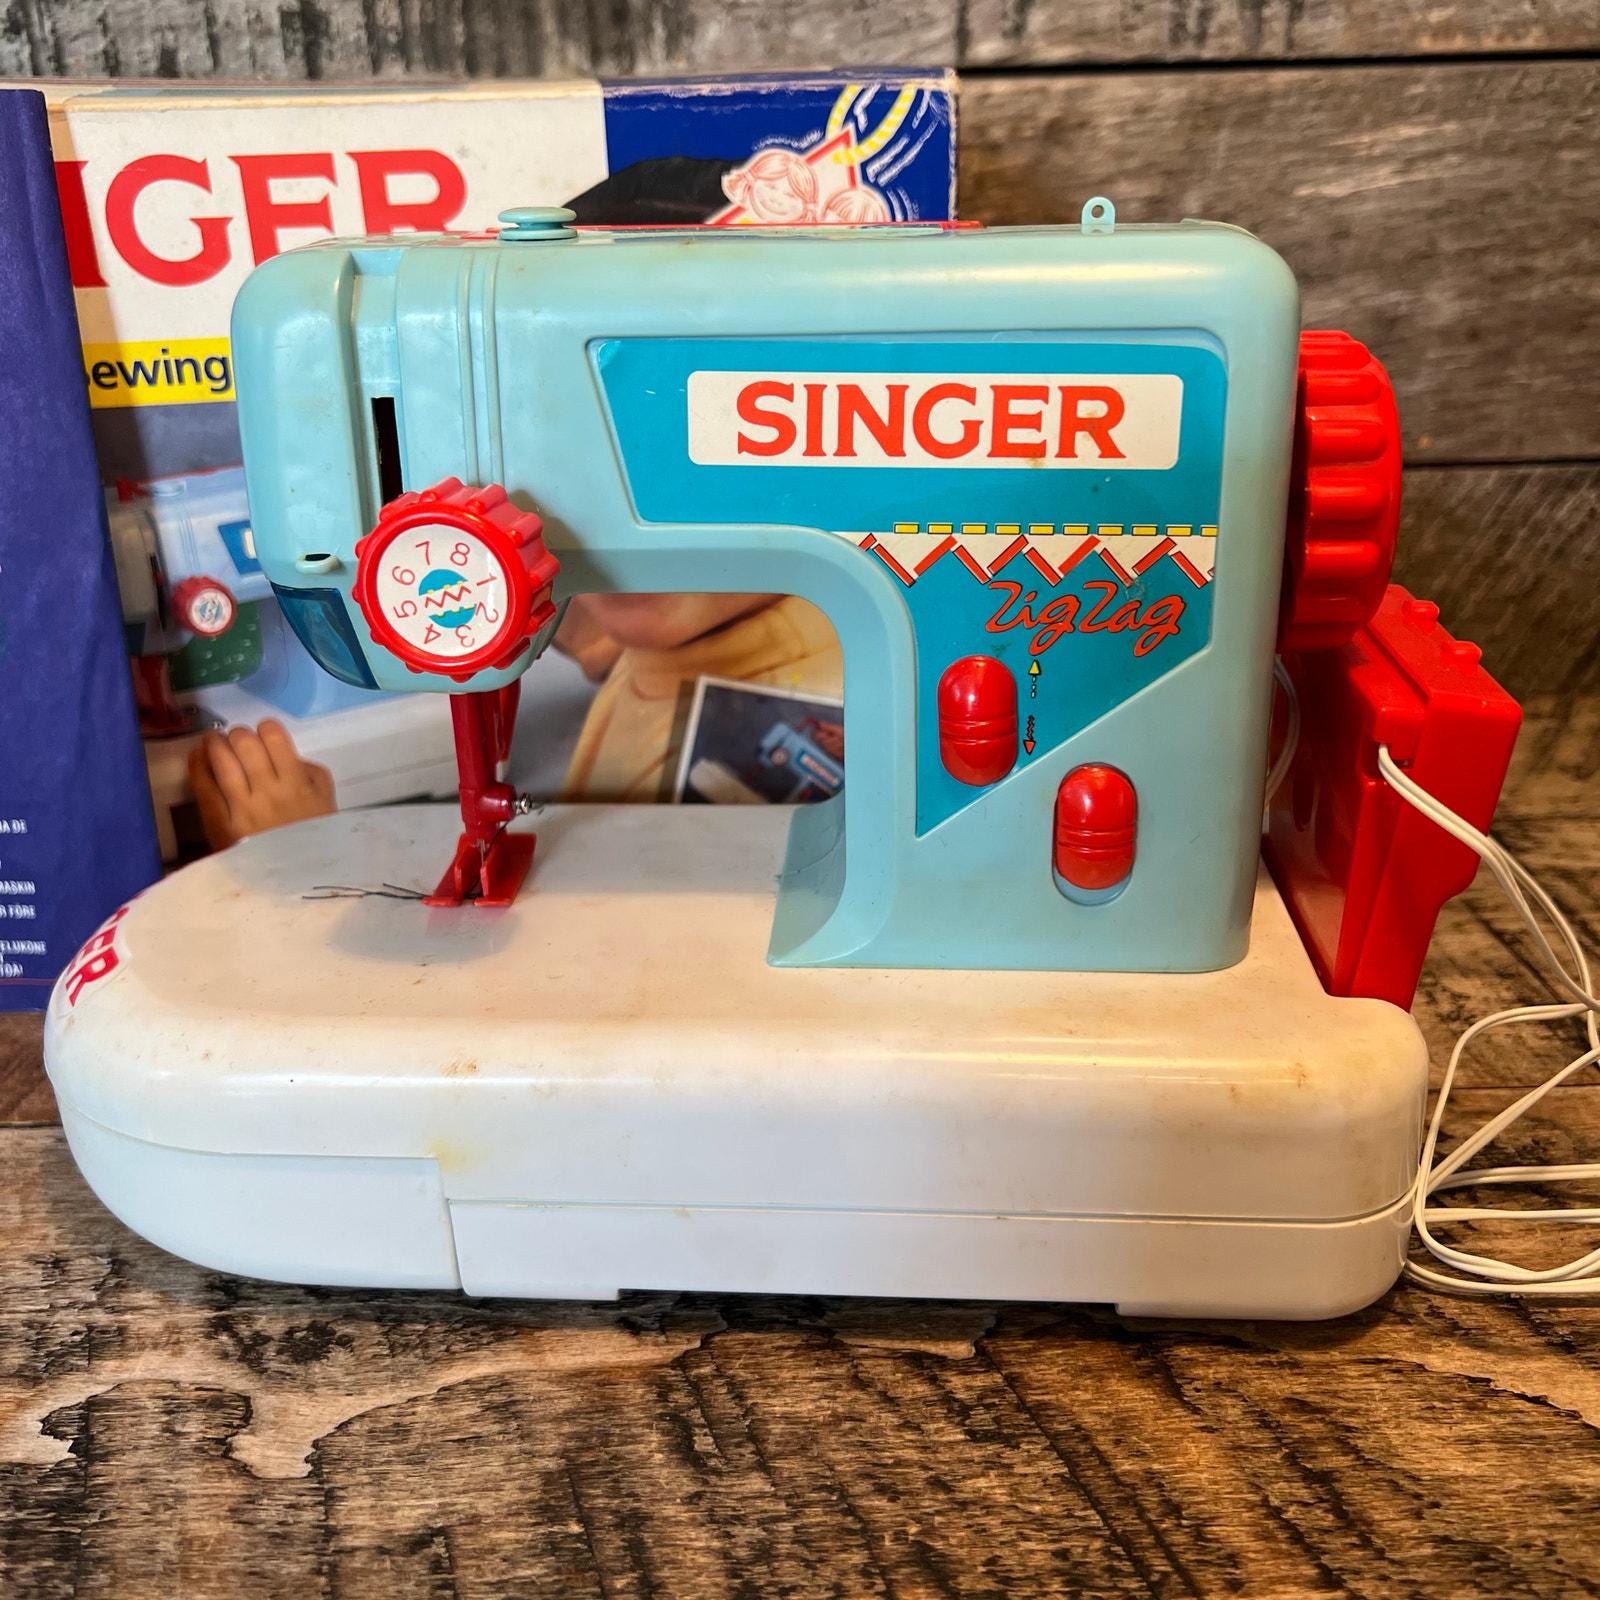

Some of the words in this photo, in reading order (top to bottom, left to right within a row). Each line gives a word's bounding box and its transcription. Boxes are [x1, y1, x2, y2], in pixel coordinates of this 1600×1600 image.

[87, 348, 231, 393] ewing
[736, 380, 1127, 459] SINGER
[415, 540, 431, 566] 7
[450, 542, 471, 567] 8
[391, 565, 416, 586] 6
[476, 573, 497, 586] 1
[393, 600, 418, 619] 5
[475, 601, 499, 624] 2
[423, 623, 442, 645] 4
[454, 624, 476, 648] 3
